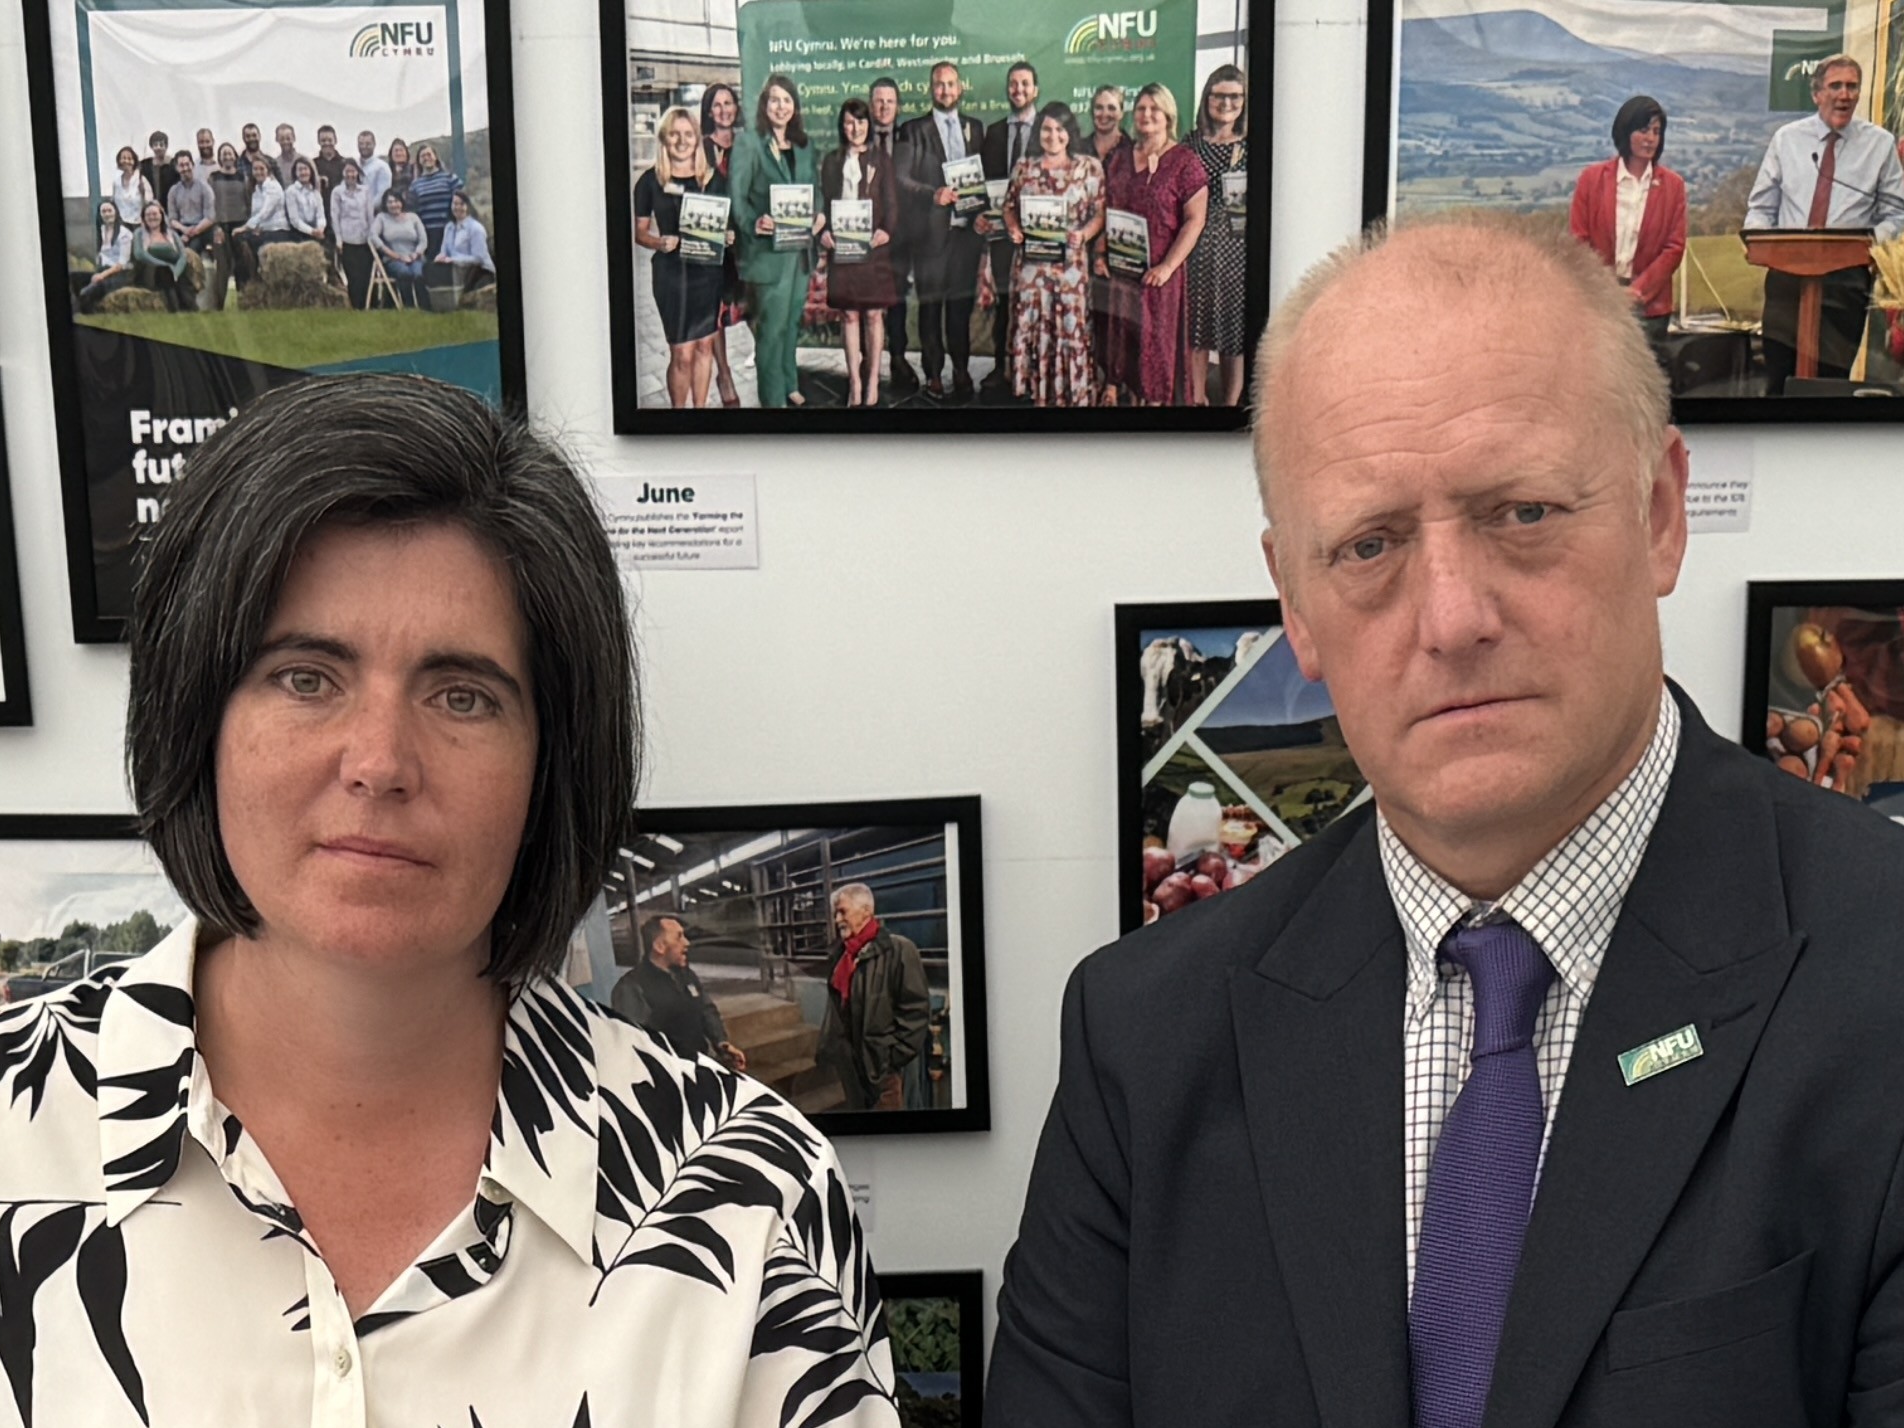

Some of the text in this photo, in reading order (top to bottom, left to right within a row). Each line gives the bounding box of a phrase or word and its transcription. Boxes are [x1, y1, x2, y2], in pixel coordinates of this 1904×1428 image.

[380, 21, 433, 46] NFU
[1098, 10, 1158, 41] NFU
[841, 36, 877, 52] We're
[879, 36, 907, 50] here
[910, 36, 929, 49] for
[637, 483, 695, 504] June
[1649, 1029, 1694, 1062] NFU
